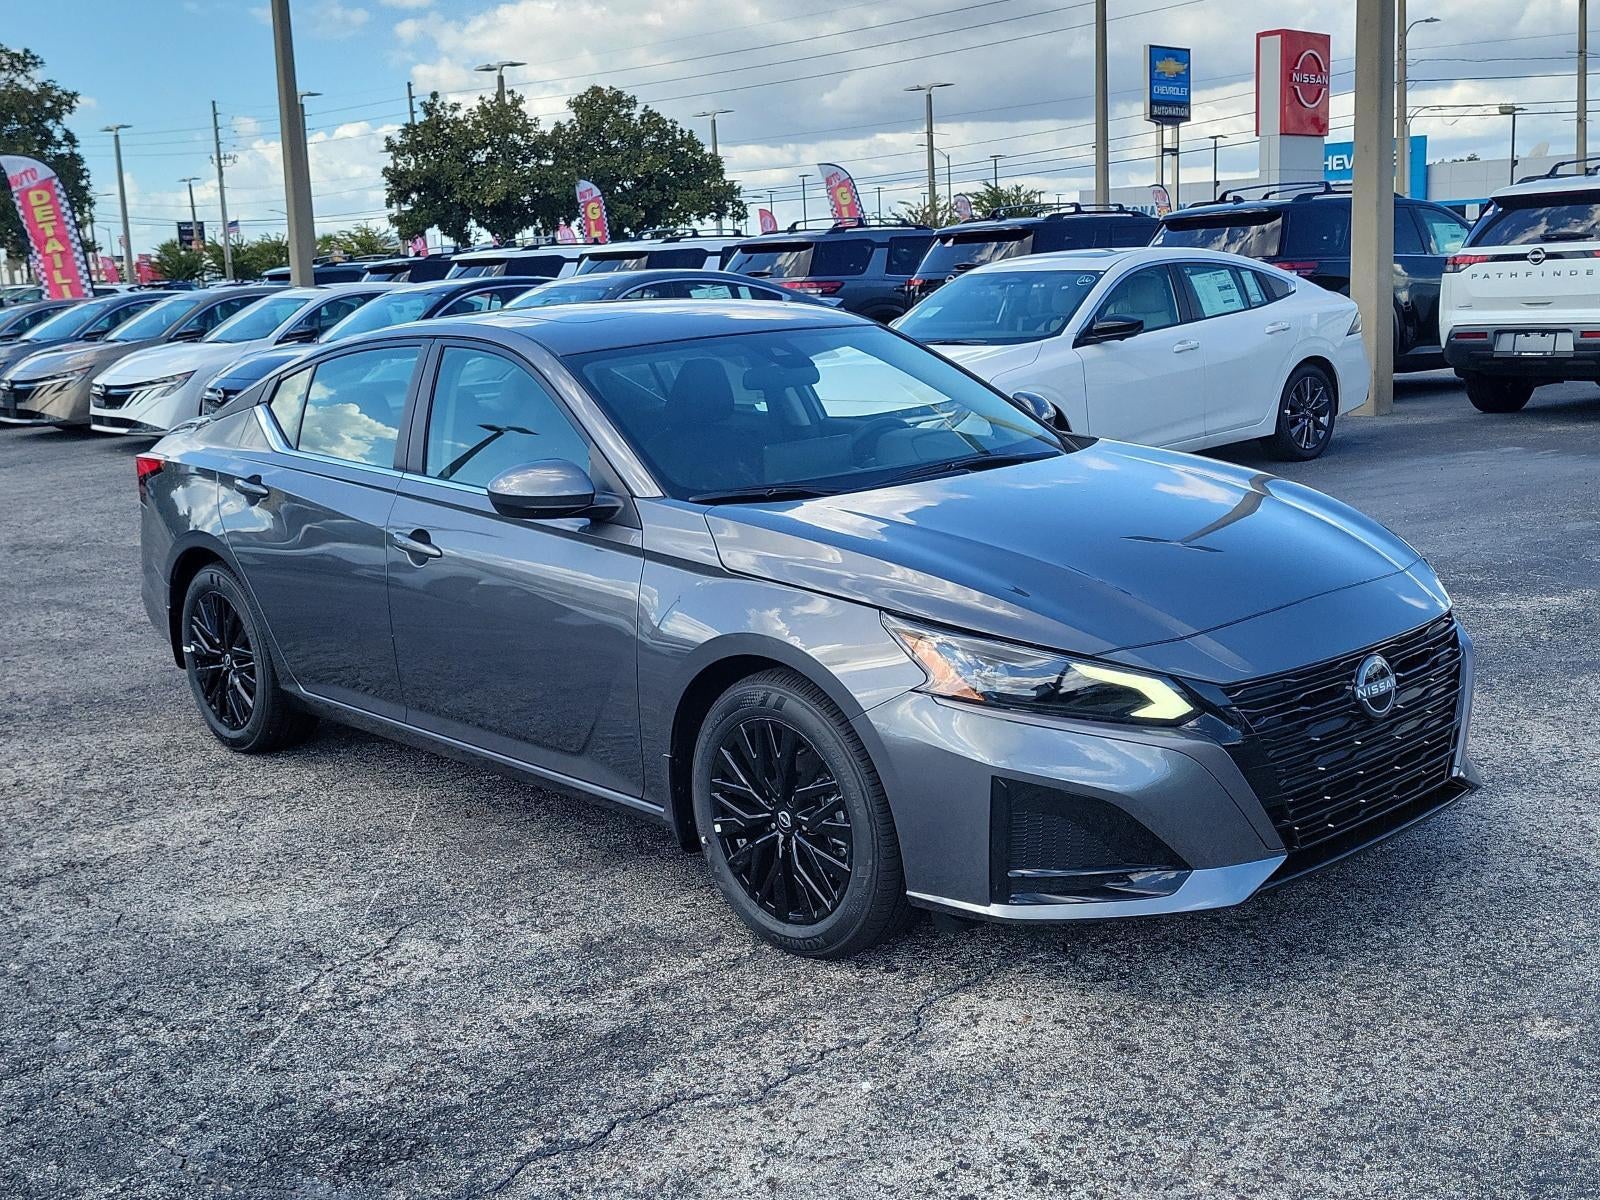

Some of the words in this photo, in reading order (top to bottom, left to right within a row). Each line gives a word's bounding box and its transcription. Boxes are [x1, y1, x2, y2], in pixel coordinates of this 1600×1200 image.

[1292, 72, 1328, 85] NISSAN
[1153, 85, 1189, 96] CHEVROLET
[1153, 106, 1189, 116] AUTONATION
[1471, 269, 1594, 280] PATHFINDE
[1357, 677, 1396, 698] NISSAN
